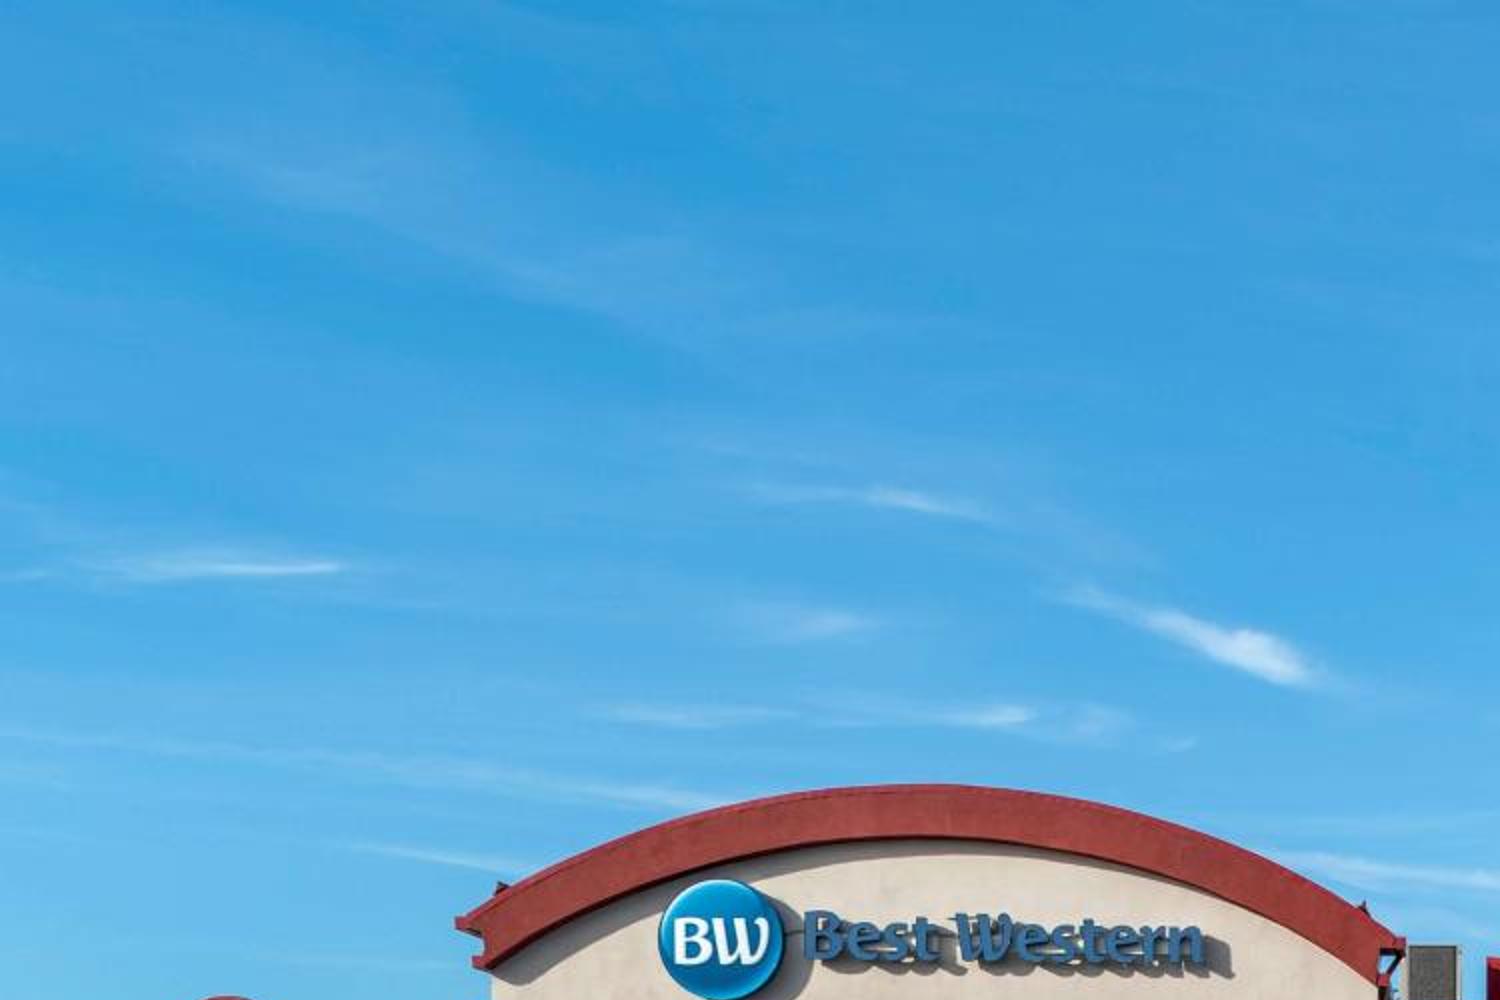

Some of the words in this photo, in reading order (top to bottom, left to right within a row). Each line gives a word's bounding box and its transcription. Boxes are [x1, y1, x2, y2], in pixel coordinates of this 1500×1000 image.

[673, 916, 770, 966] BW
[803, 909, 942, 961] Best
[954, 912, 1206, 963] Western
